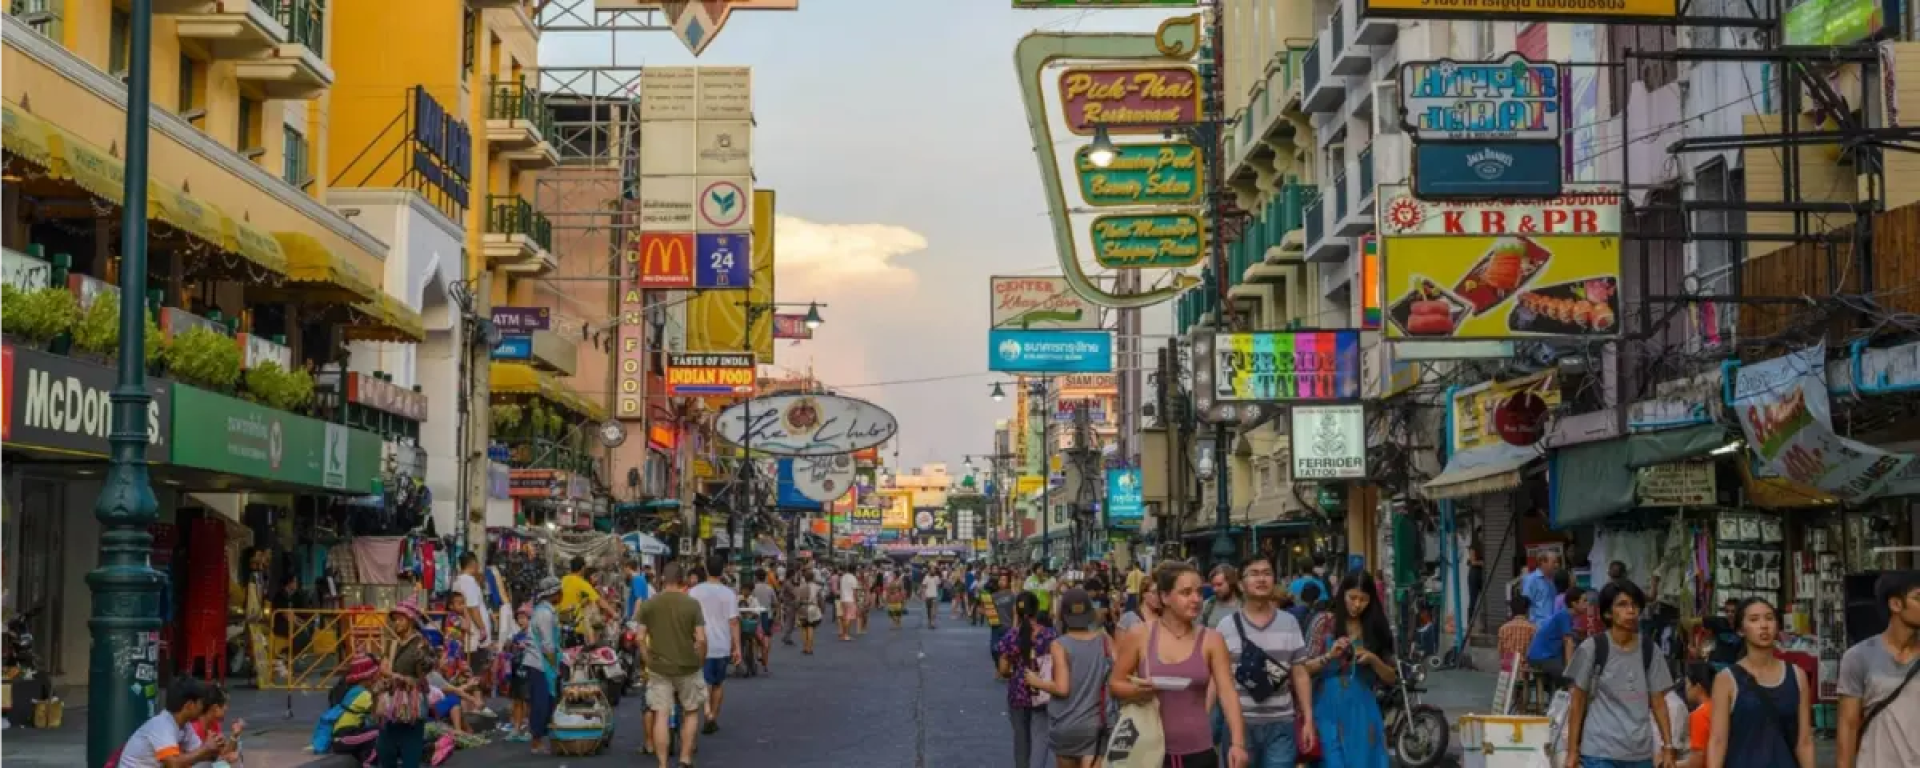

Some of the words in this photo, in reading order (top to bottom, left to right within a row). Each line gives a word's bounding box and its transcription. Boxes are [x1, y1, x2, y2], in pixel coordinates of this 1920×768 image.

[1067, 73, 1193, 99] Pick-Thai
[1083, 102, 1181, 123] Restaurant
[709, 252, 735, 270] 24
[995, 281, 1054, 293] CENTER
[492, 314, 519, 326] ATM
[672, 356, 704, 366] TASTE
[706, 356, 718, 366] OF
[720, 356, 750, 366] INDIA
[623, 338, 638, 413] FOOD
[670, 370, 716, 384] INDIAN
[719, 370, 752, 384] FOOD
[736, 408, 788, 442] The
[1298, 458, 1363, 468] FERRIDER
